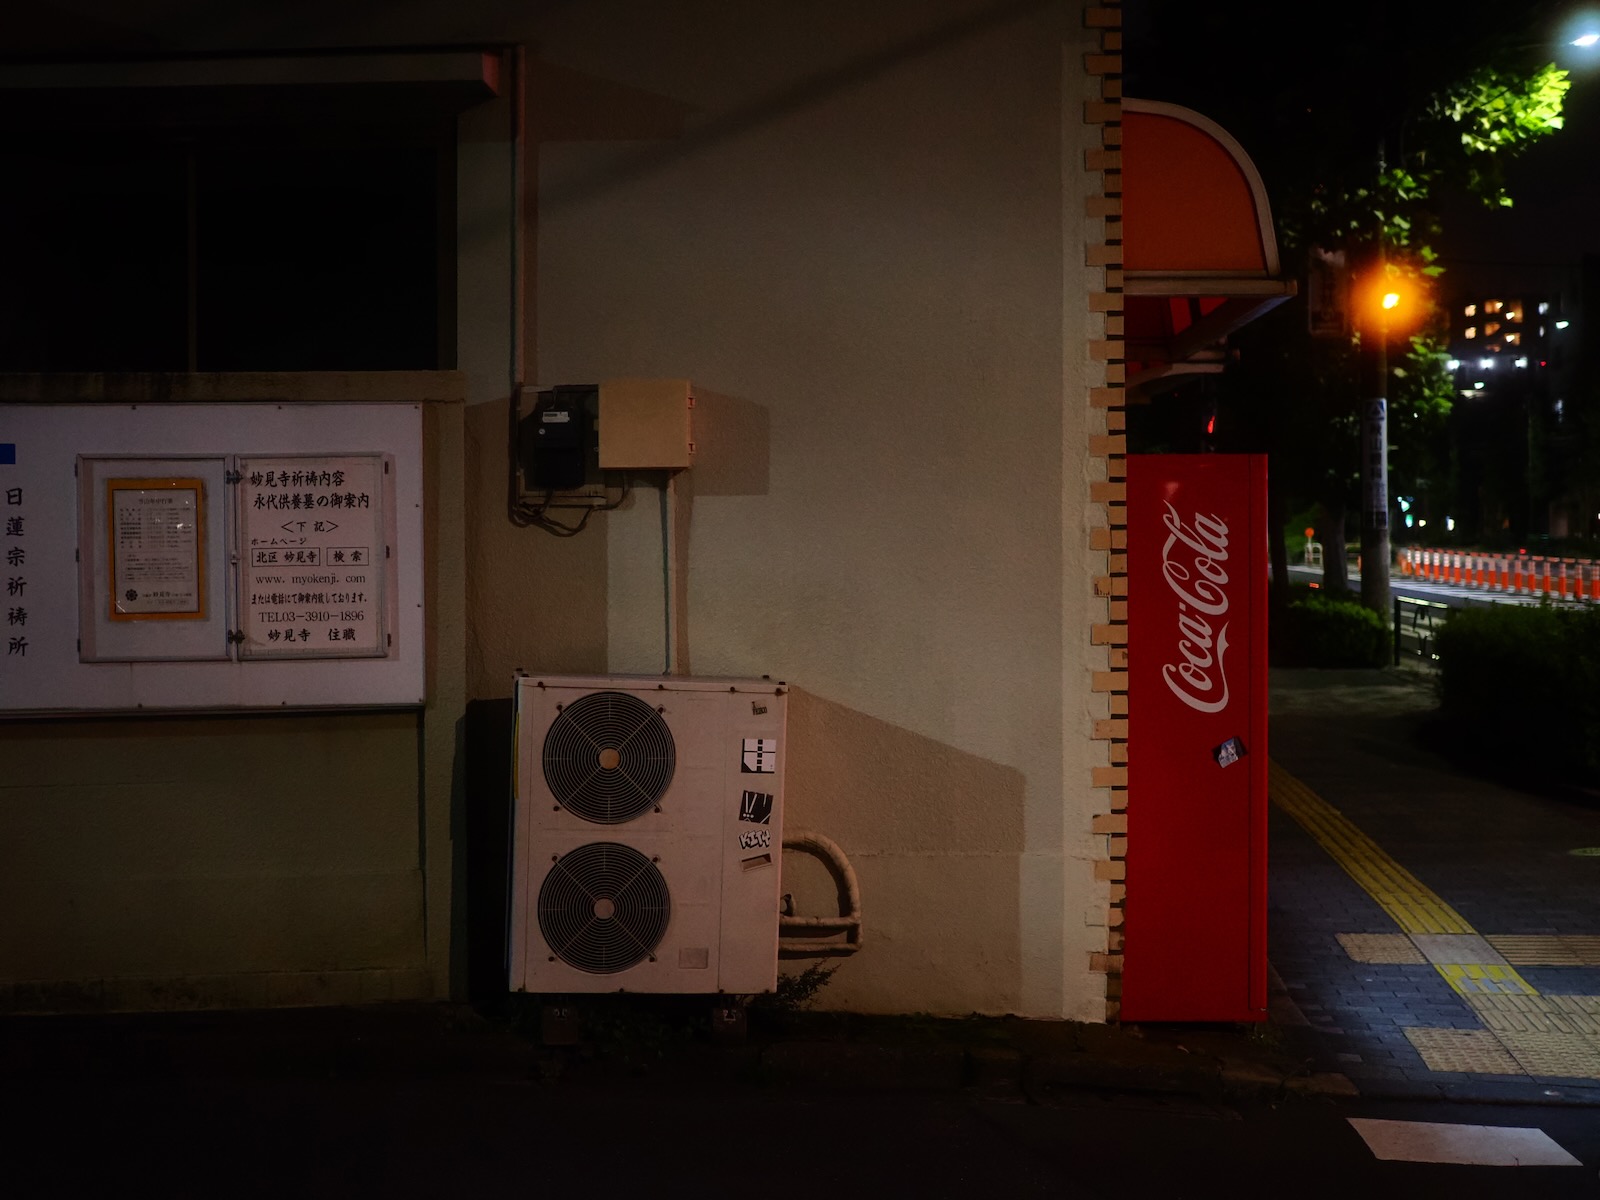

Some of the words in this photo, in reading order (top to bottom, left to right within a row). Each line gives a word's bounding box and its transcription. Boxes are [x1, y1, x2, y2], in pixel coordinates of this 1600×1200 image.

[253, 492, 370, 510] 永代供養墓の御案内
[256, 551, 278, 563] 北区
[284, 551, 317, 563] 妙見寺
[1162, 499, 1229, 714] Coca-Cola
[268, 628, 311, 642] 妙見寺
[328, 628, 356, 641] 住職
